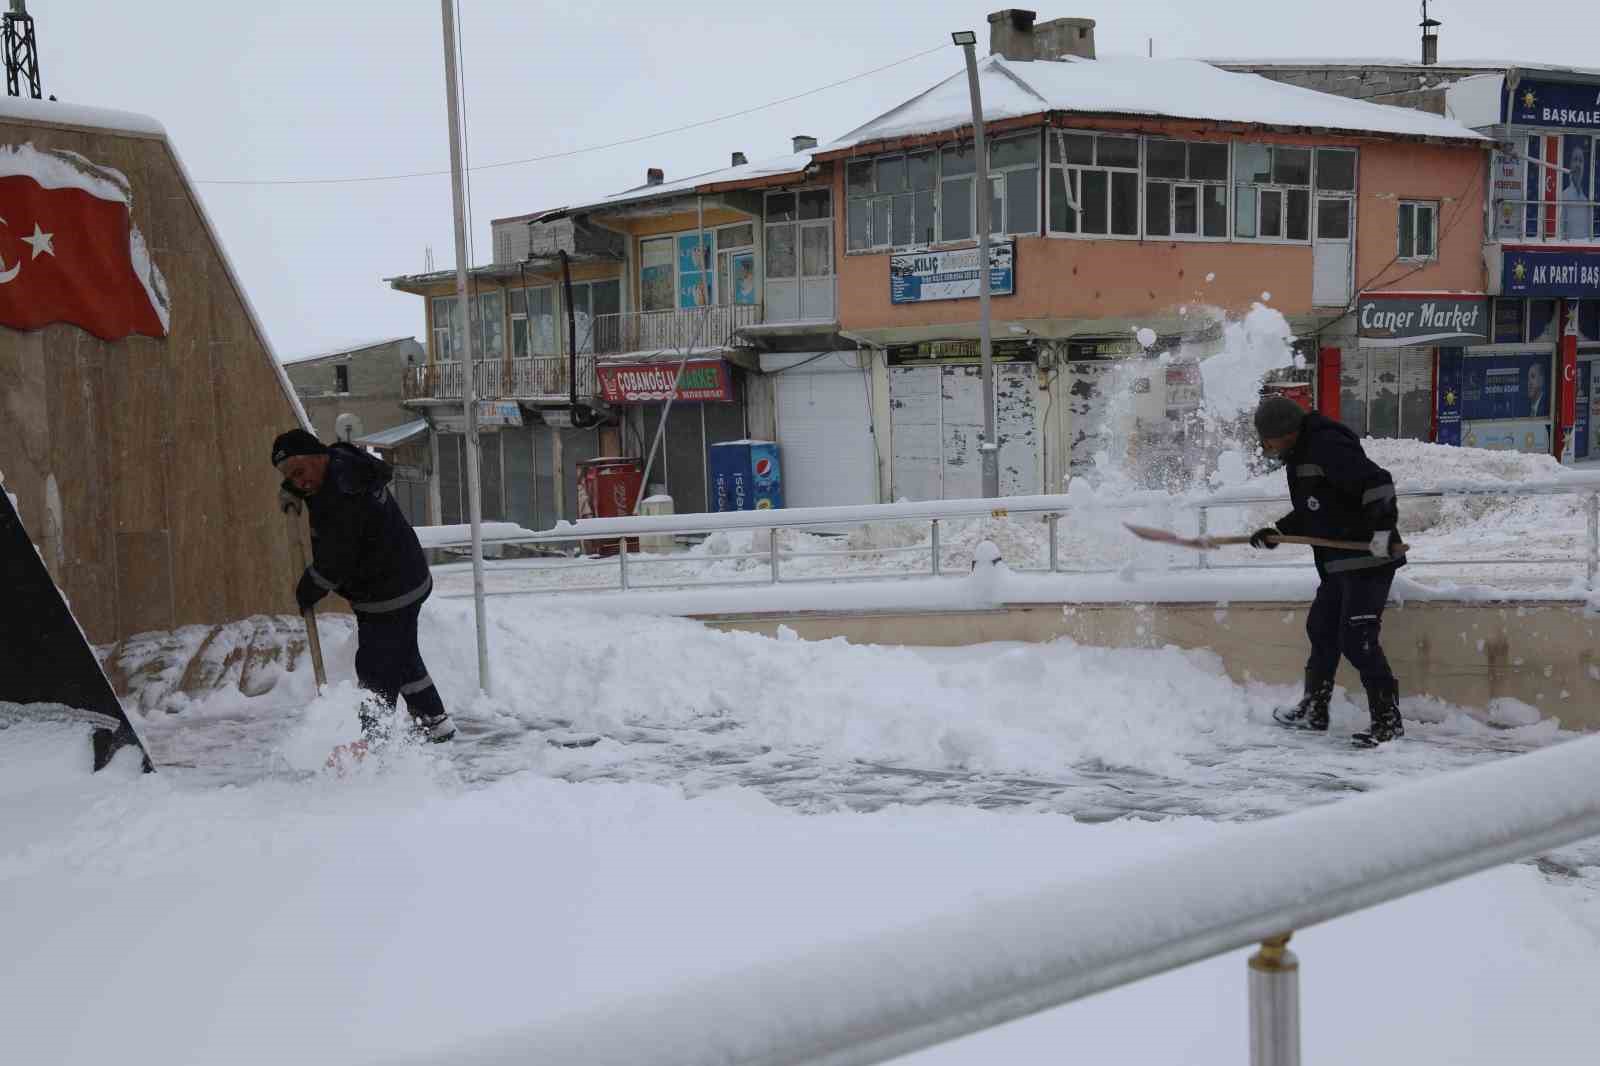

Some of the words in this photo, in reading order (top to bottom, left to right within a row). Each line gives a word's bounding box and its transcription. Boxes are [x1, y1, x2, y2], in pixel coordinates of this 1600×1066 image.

[1533, 265, 1546, 284] AK
[1550, 261, 1578, 284] PARTİ
[1361, 302, 1414, 333] Caner
[1419, 303, 1479, 332] Market
[732, 472, 745, 511] epsi
